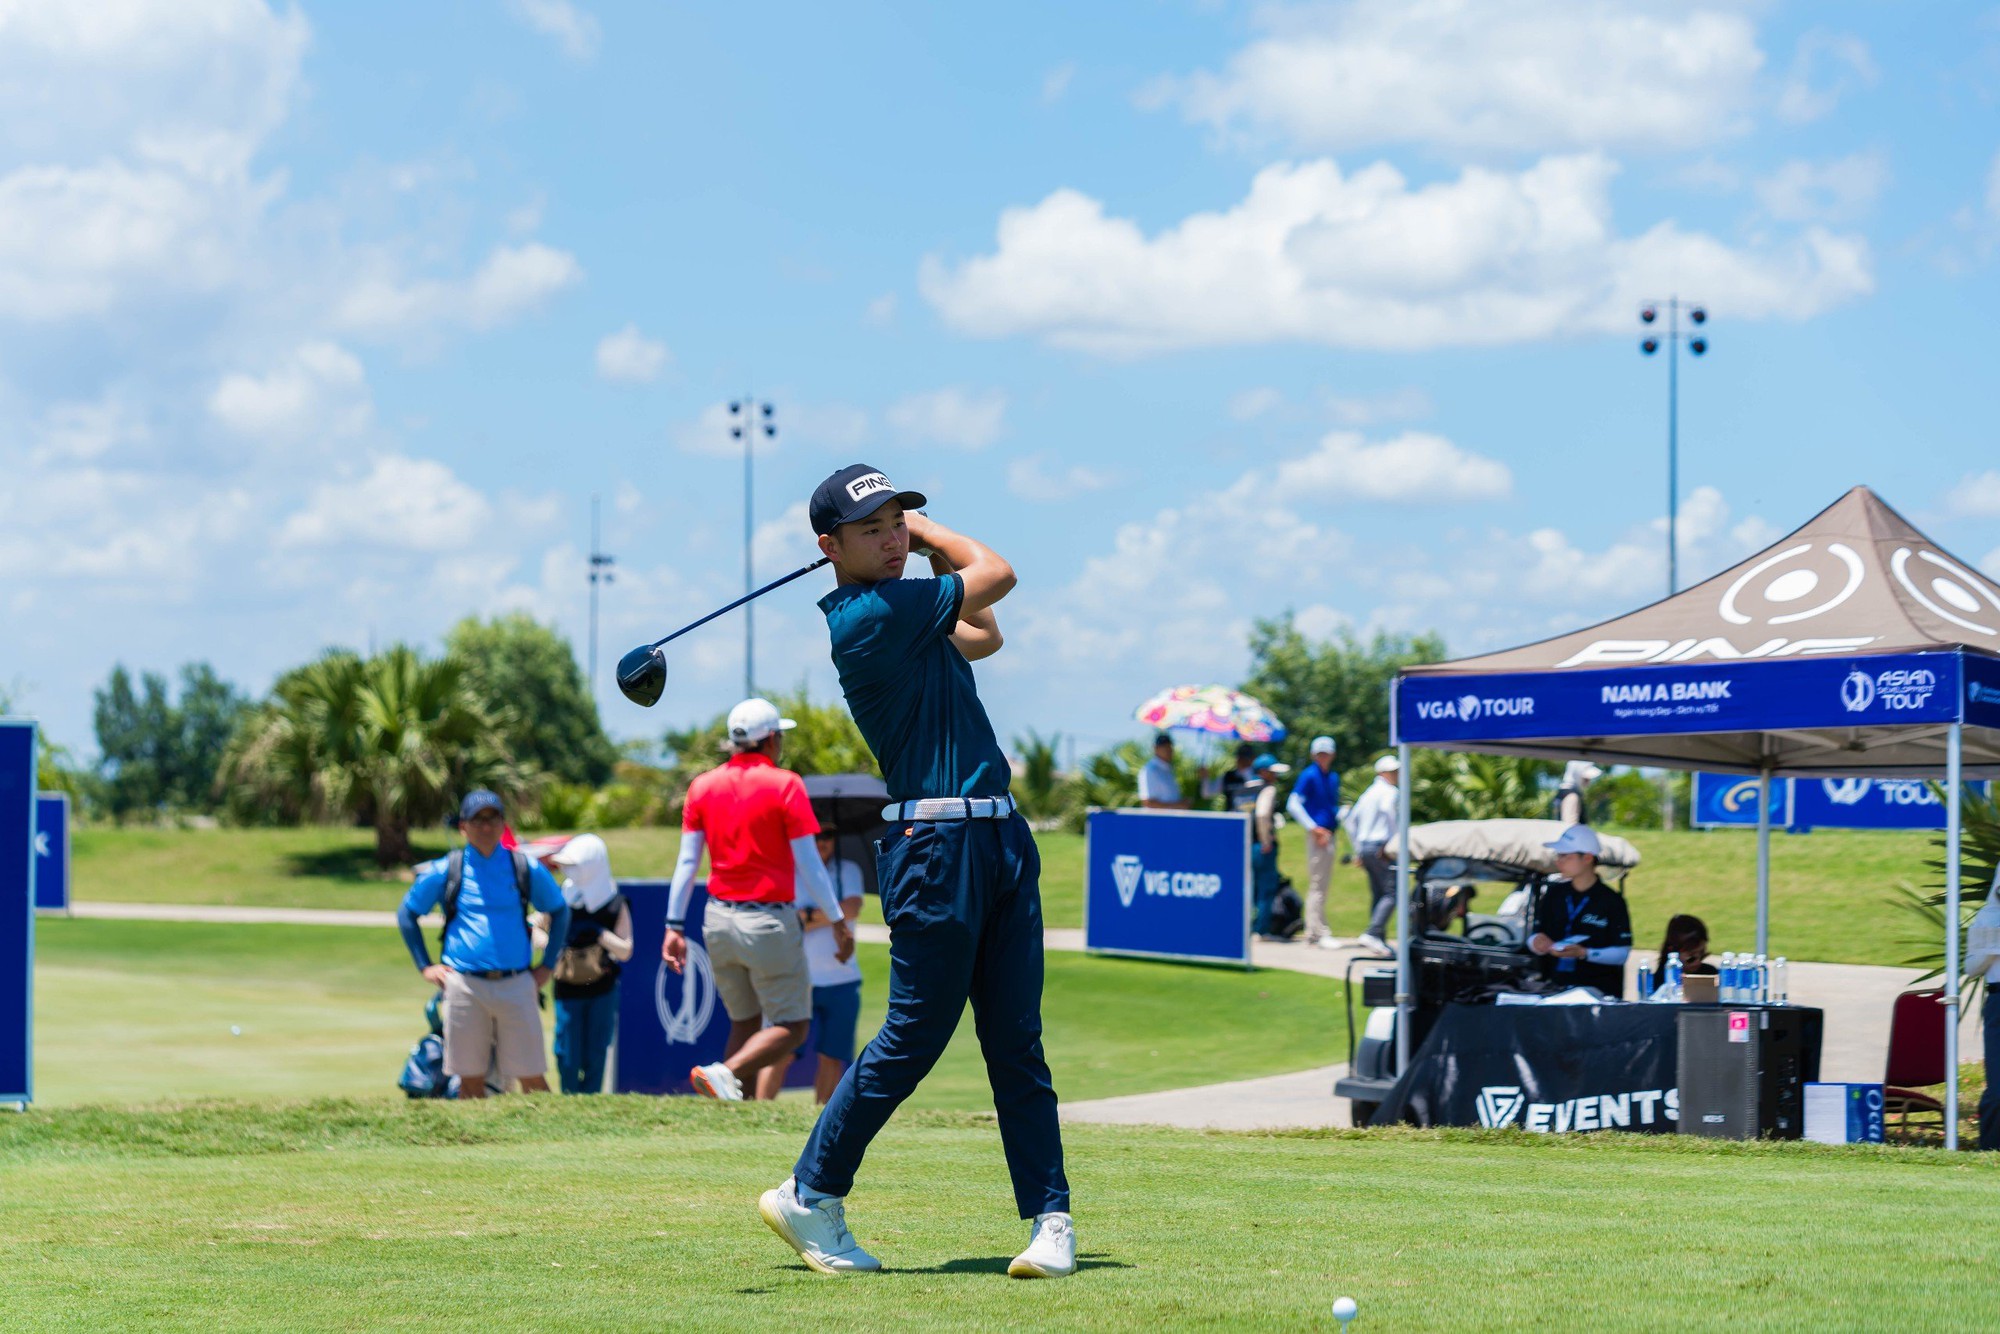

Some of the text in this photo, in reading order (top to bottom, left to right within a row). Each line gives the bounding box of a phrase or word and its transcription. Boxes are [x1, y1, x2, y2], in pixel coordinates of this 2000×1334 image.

[852, 476, 892, 496] PING
[1601, 684, 1652, 704] NAM
[1671, 680, 1732, 701] BANK
[1416, 697, 1534, 719] VGA TOUR
[1143, 870, 1222, 898] VG CORP
